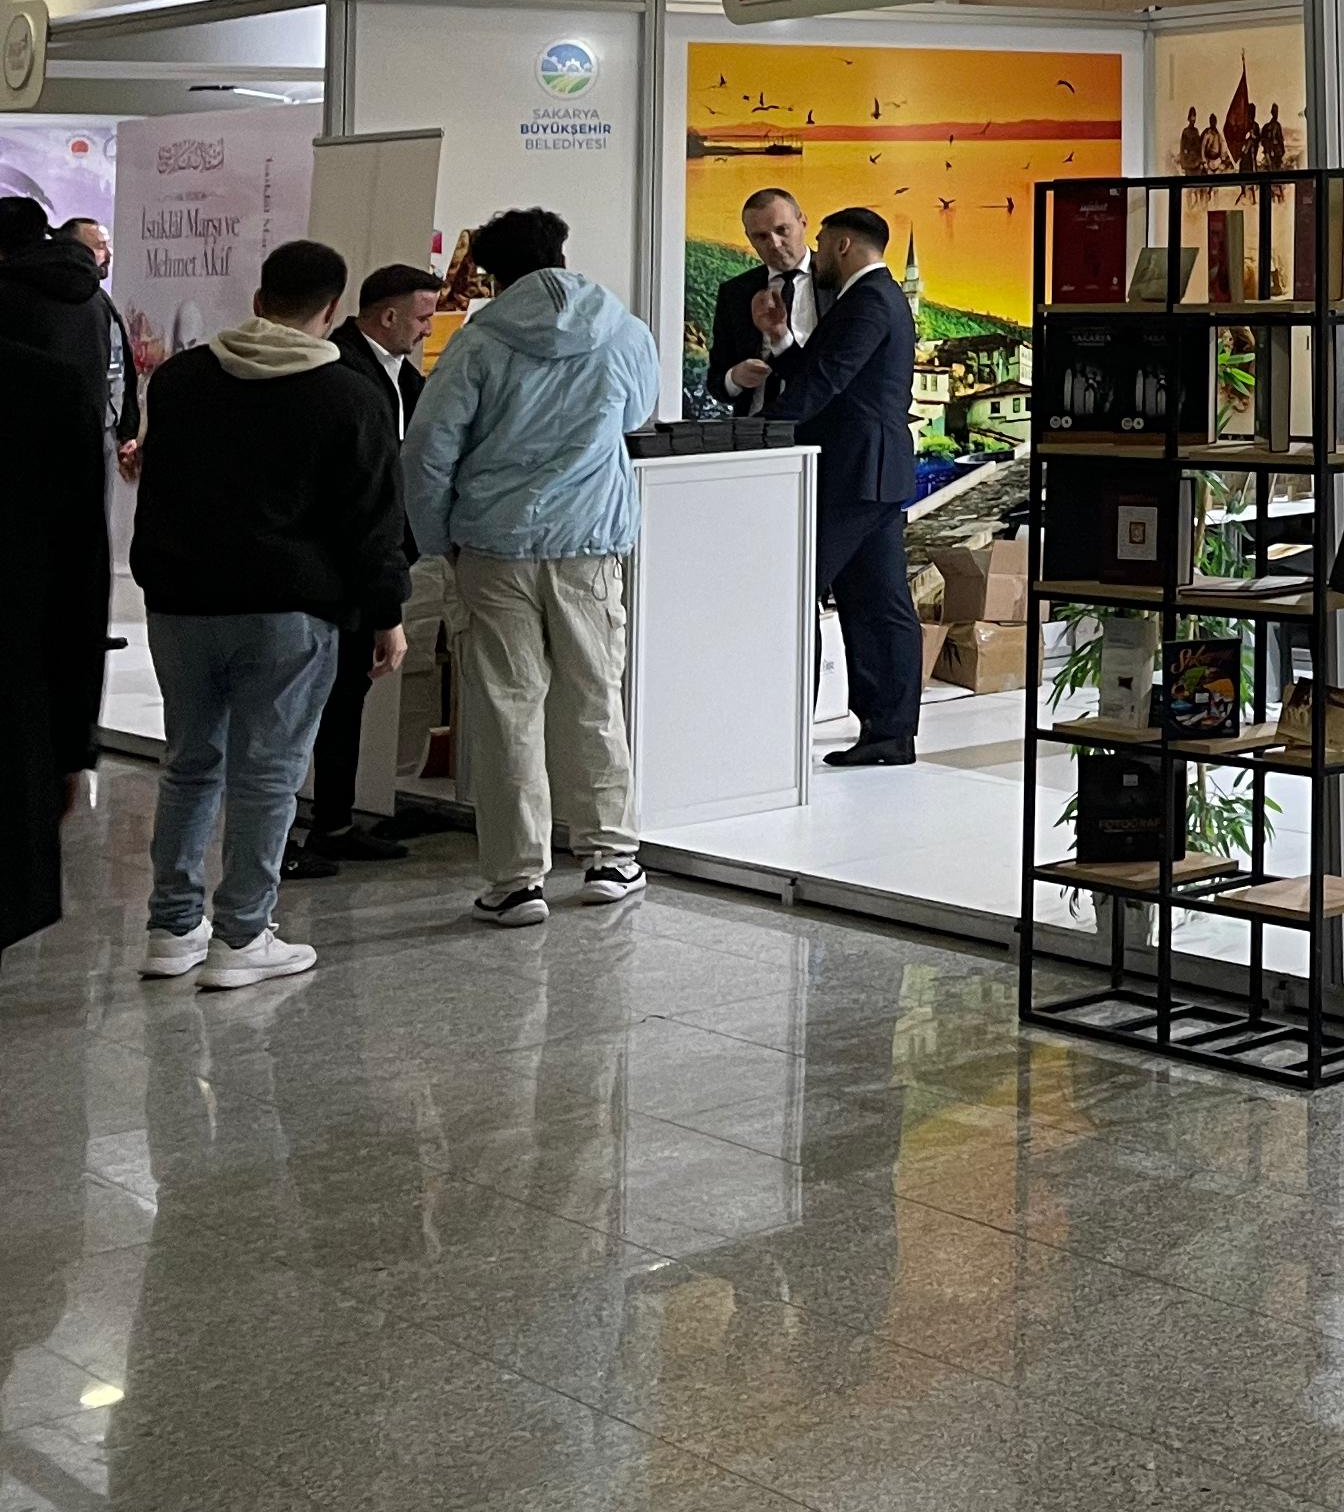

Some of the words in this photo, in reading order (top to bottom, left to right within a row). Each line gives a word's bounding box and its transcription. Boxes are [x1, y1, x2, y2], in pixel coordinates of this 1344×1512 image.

[533, 108, 600, 120] SAKARYA
[520, 121, 612, 137] BÜYÜKŞEHİR
[525, 137, 607, 150] BELEDİYESİ
[146, 247, 198, 278] Mehmet
